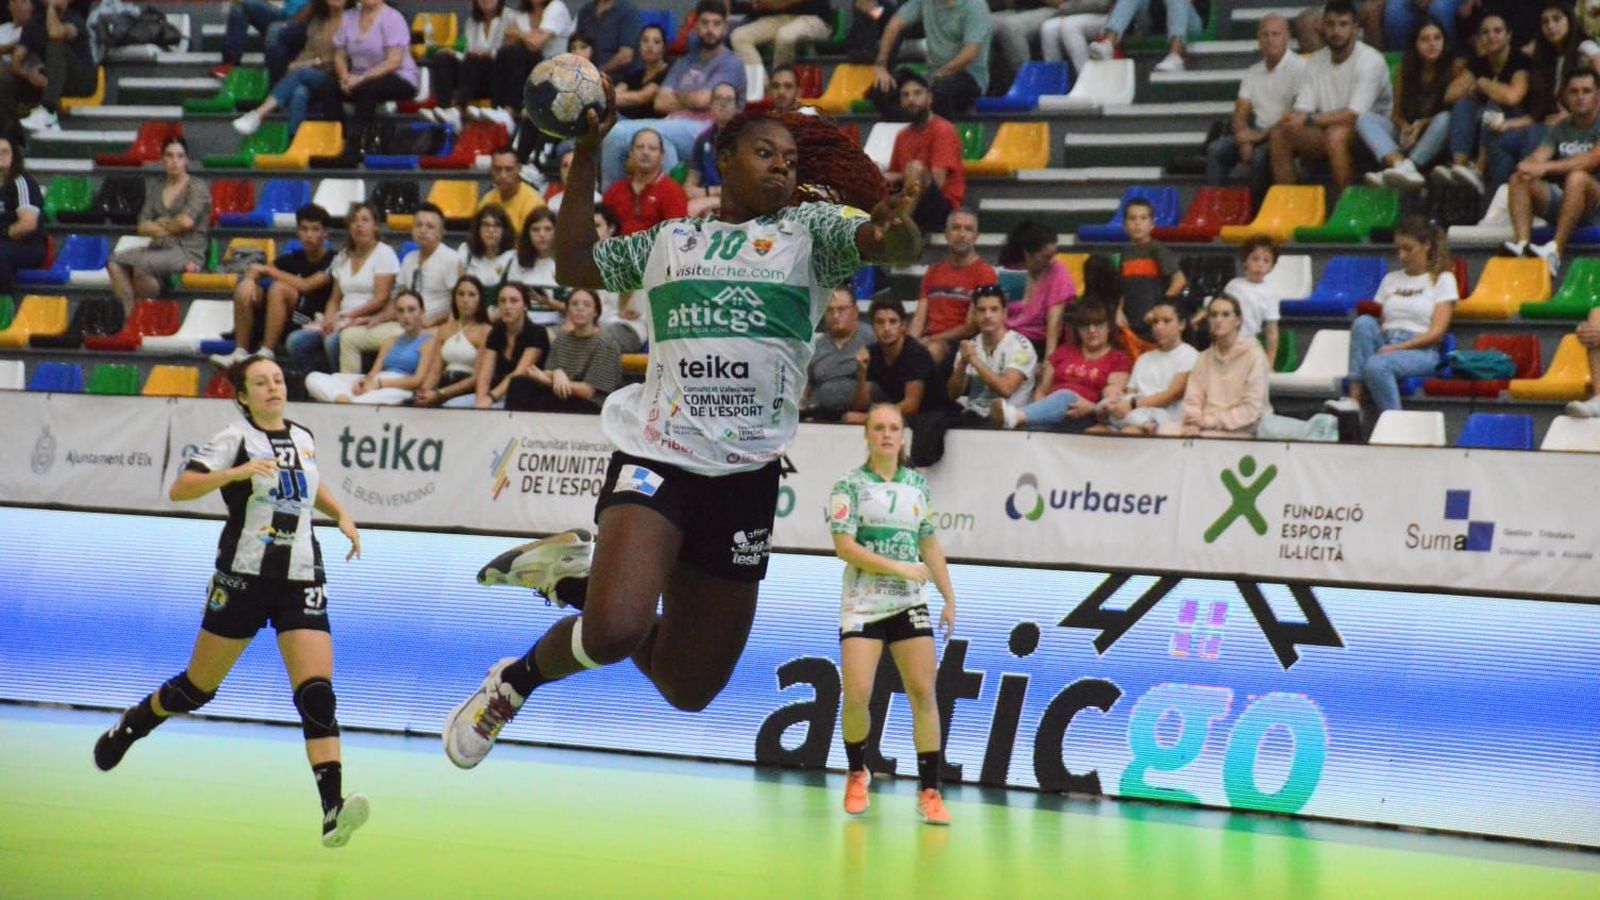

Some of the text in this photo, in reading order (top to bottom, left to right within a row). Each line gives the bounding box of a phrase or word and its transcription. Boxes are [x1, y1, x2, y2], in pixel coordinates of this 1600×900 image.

[704, 229, 748, 260] 10
[676, 264, 785, 280] visitelche.com
[668, 299, 767, 333] atticgo
[679, 354, 749, 379] teika
[683, 394, 756, 406] COMUNITAT
[690, 405, 764, 417] DE L'ESPORT
[338, 422, 443, 472] teika
[520, 437, 569, 450] Comunitat
[65, 451, 124, 466] Ajuntament
[521, 475, 544, 494] DE
[547, 476, 602, 497] L'ESPO
[1050, 480, 1168, 515] urbaser
[886, 490, 897, 514] 7
[1282, 503, 1364, 522] FUNDACIÓ
[1281, 523, 1343, 541] ESPORT
[1405, 523, 1467, 551] Suma
[303, 586, 323, 609] 27
[755, 621, 1328, 813] atticgo
